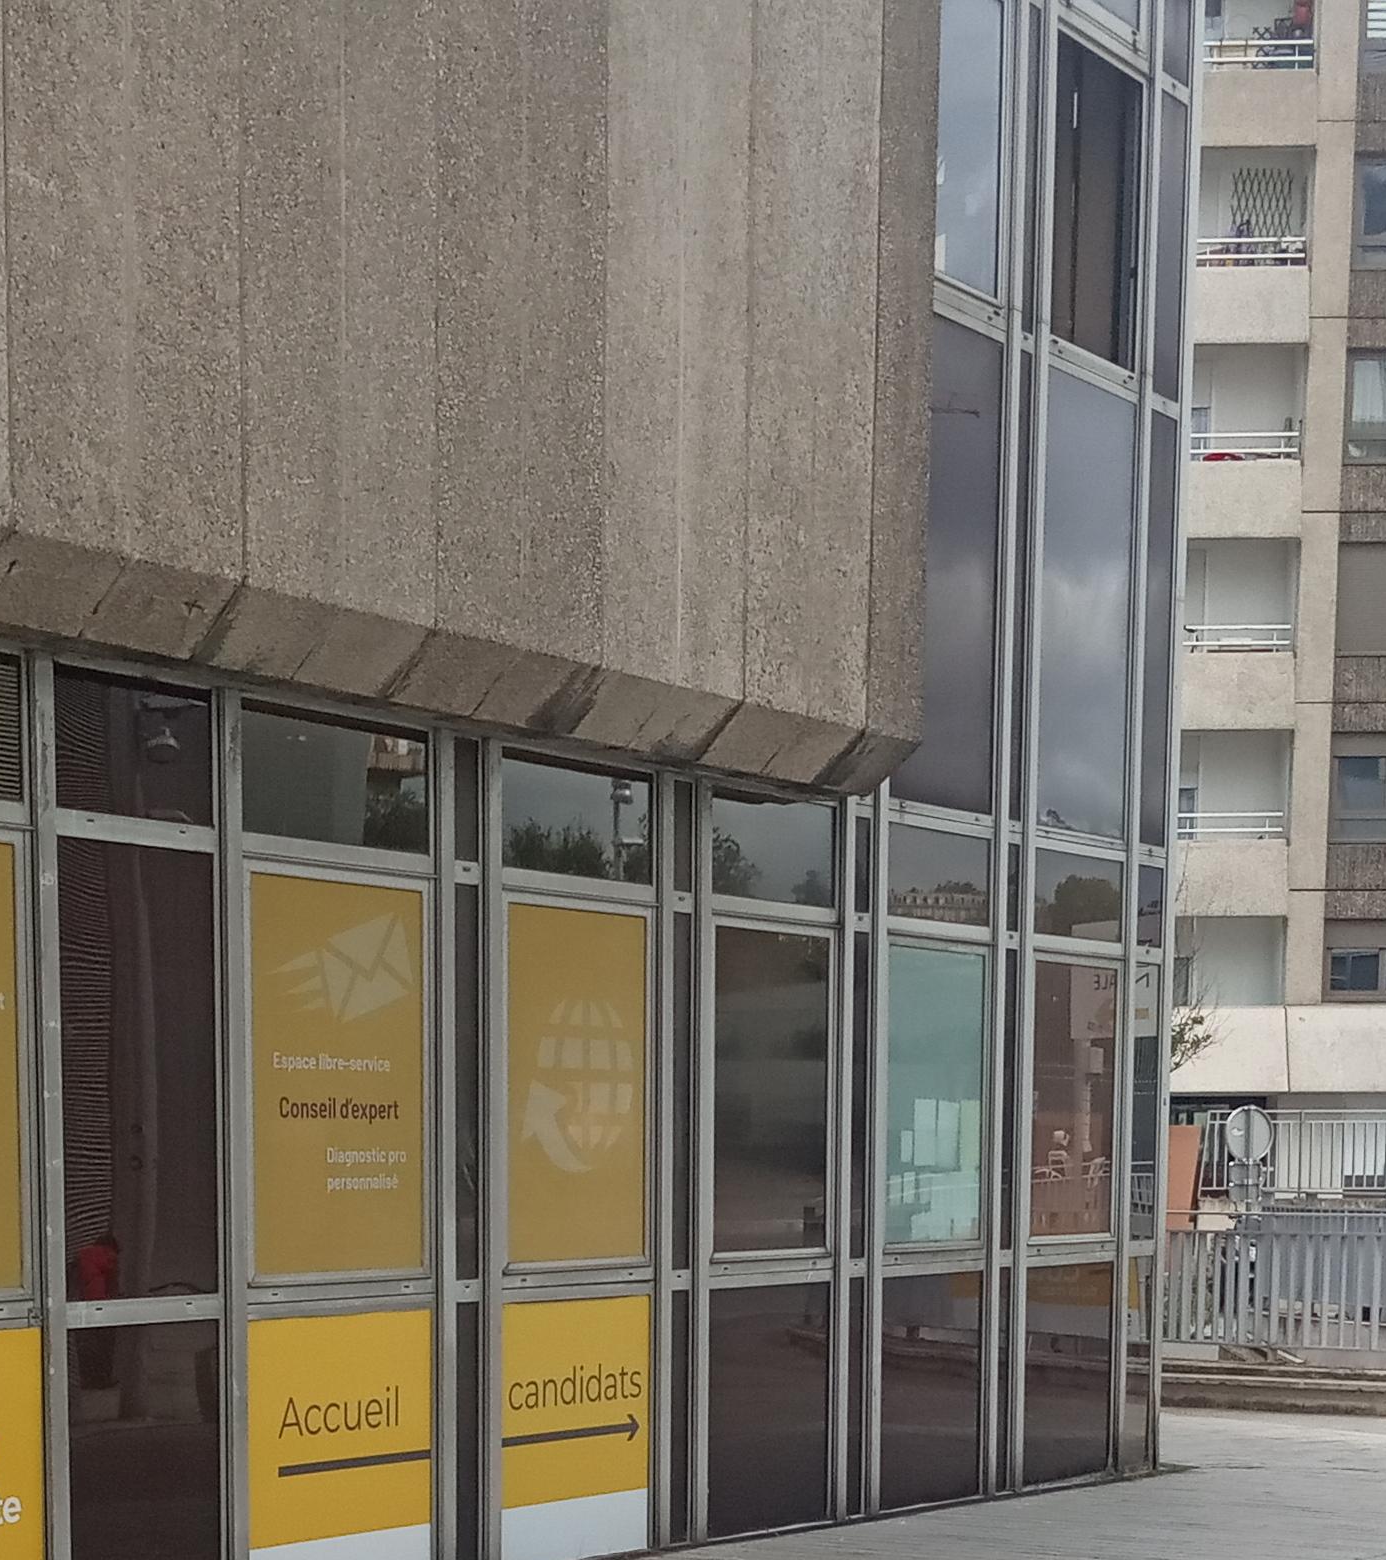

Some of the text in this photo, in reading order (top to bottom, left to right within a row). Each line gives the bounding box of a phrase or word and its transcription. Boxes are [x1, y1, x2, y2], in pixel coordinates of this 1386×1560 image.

[272, 1051, 391, 1073] Espace libre-service
[279, 1096, 399, 1124] Conseil d'expert
[326, 1147, 407, 1167] Diagnostic pro
[326, 1173, 399, 1193] personnalisé
[278, 1363, 643, 1439] Accueil candidats
